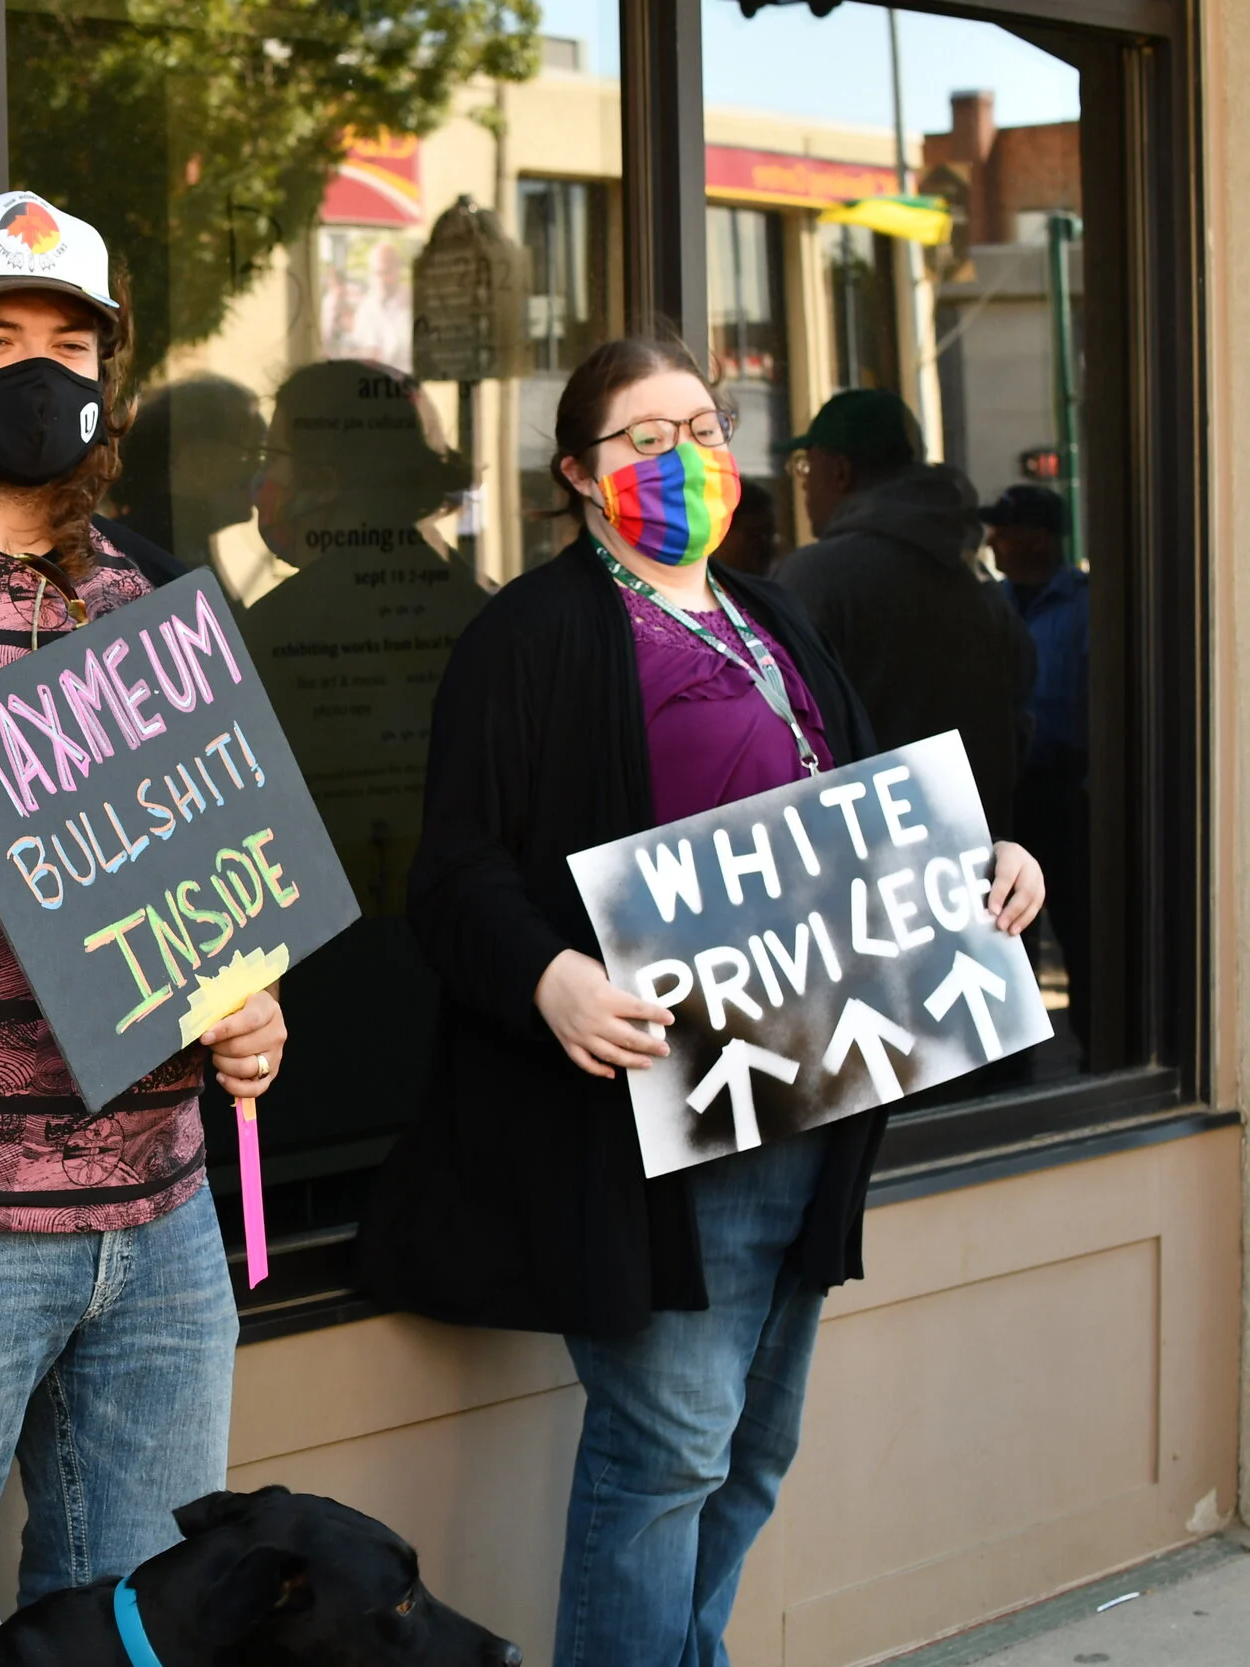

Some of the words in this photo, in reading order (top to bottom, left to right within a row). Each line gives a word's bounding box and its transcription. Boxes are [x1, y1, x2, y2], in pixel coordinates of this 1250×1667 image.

[305, 521, 395, 553] opening
[354, 569, 387, 588] sept
[6, 720, 265, 910] BULLSHIT!
[635, 765, 928, 923] WHITE
[84, 827, 299, 1036] INSIDE
[635, 845, 998, 1042] PRIVILEGE
